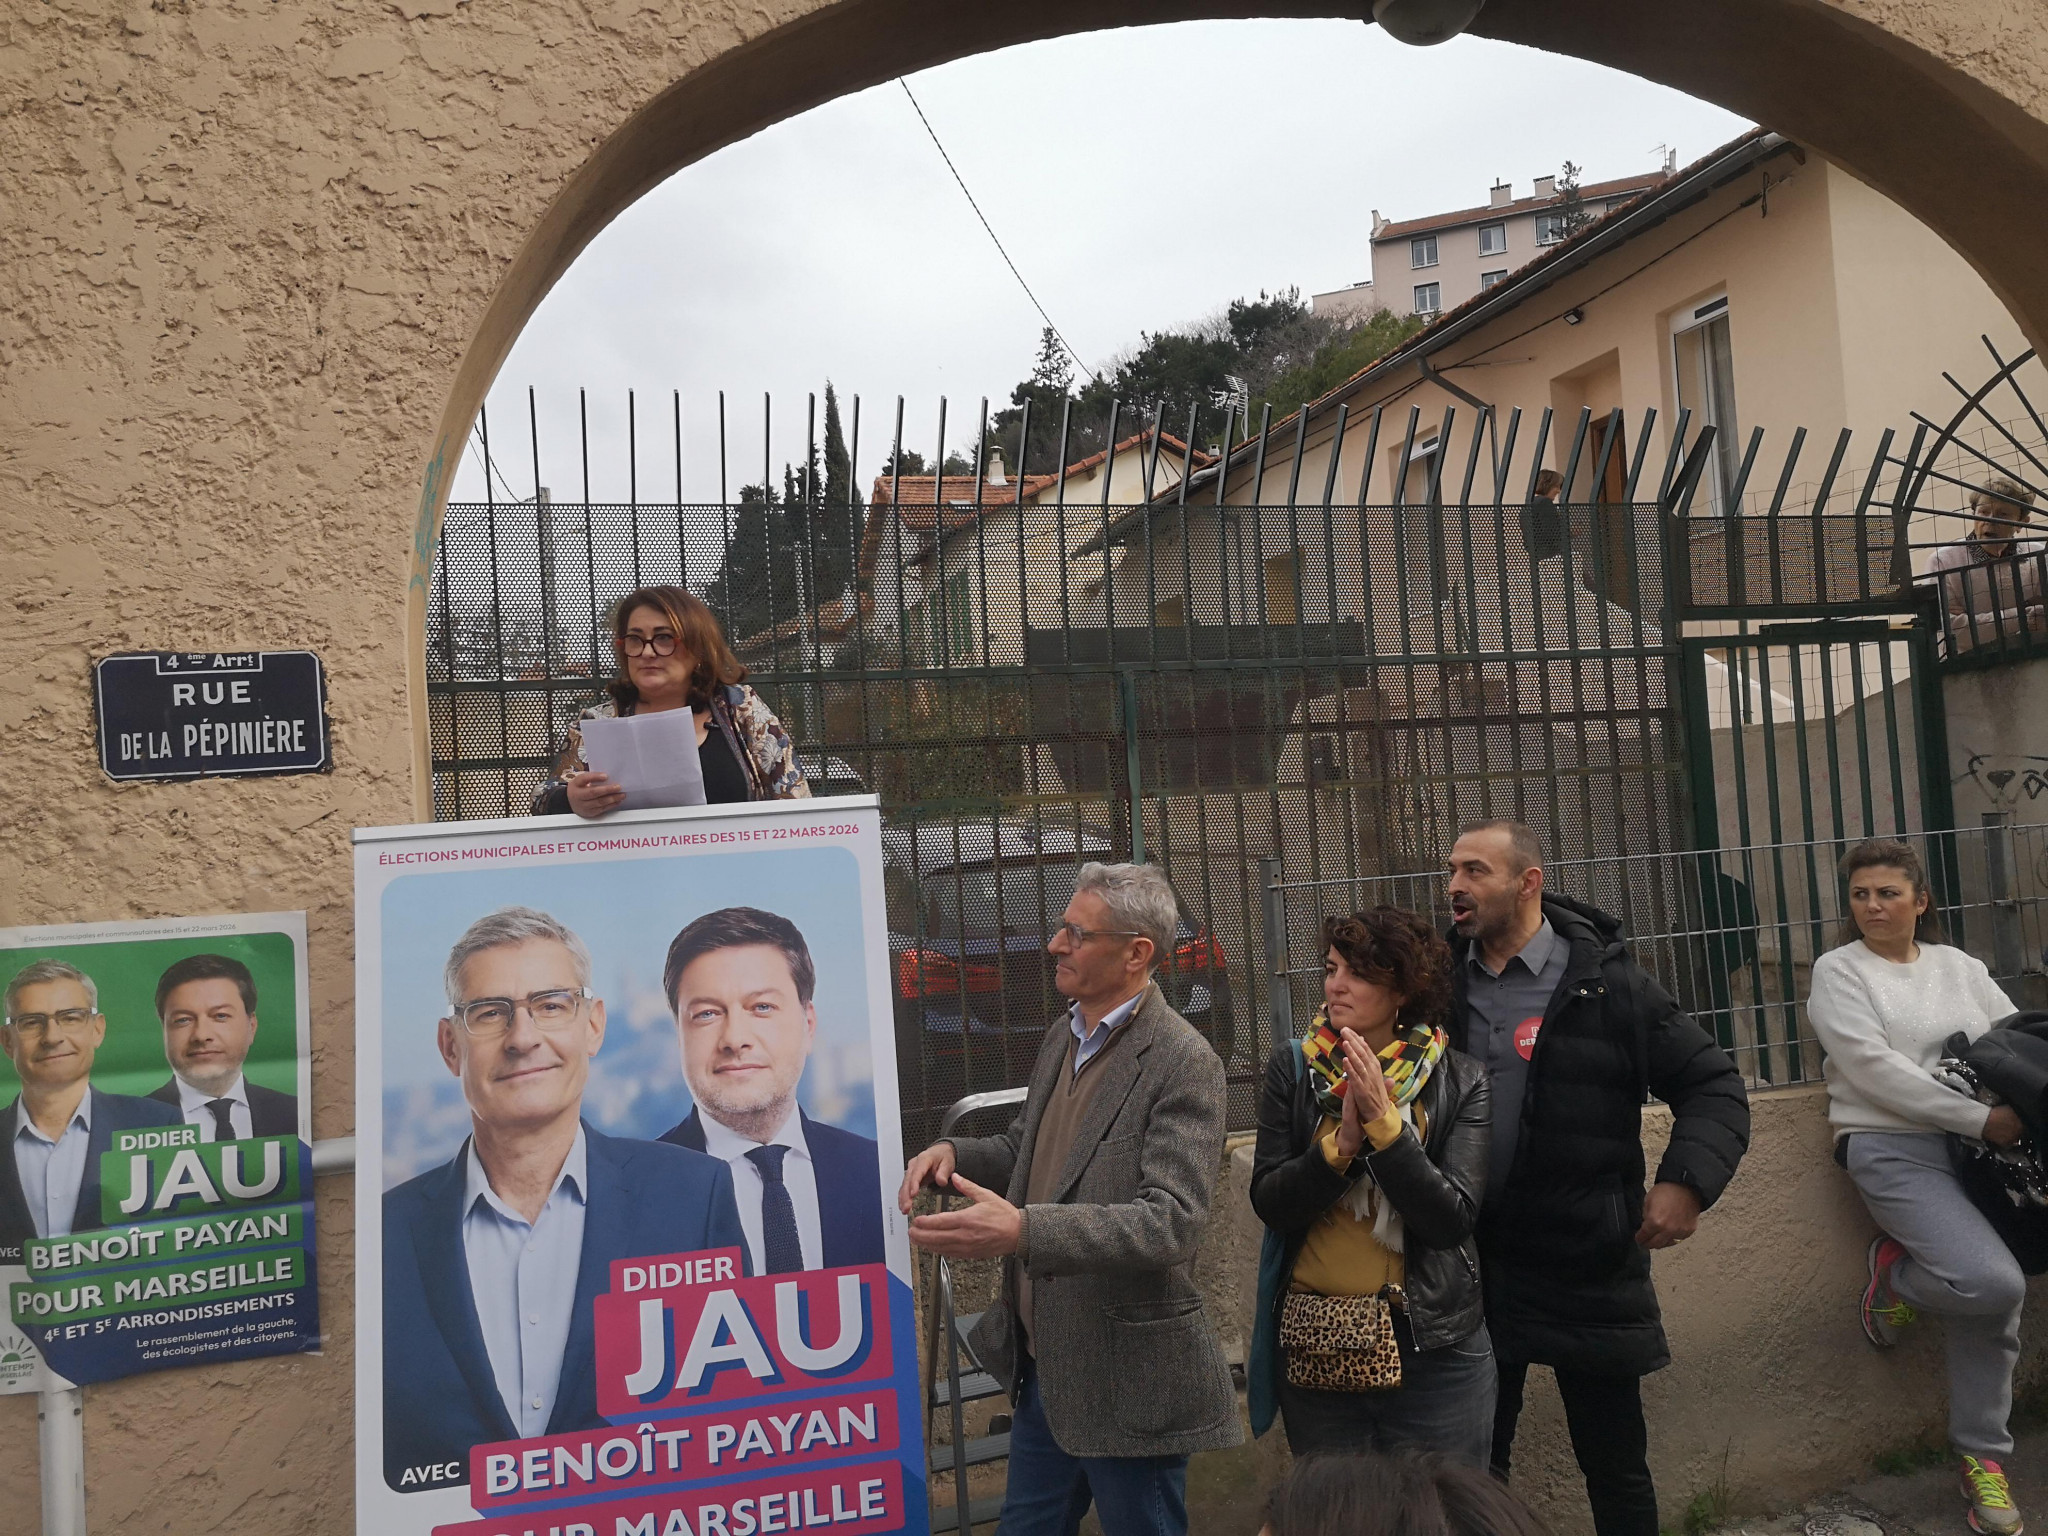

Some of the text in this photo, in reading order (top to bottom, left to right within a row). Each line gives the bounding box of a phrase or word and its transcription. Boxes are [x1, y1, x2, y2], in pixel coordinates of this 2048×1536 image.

[167, 655, 179, 668] 4
[173, 681, 251, 706] RUE
[121, 715, 306, 760] DE LA PÉPINIÈRE
[379, 823, 860, 866] ÉLECTIONS MUNICIPALES ET COMMUNAUTAIRES DES 15 ET 22 MARS 2026
[56, 932, 96, 941] municipales
[105, 928, 161, 938] communautaires
[120, 1129, 196, 1151] DIDIER
[120, 1140, 281, 1214] JAU
[0, 1213, 288, 1269] VEC BENOÎT PAYAN
[17, 1257, 293, 1314] POUR MARSEILLE
[623, 1256, 736, 1292] DIDIER
[66, 1323, 89, 1340] ET
[117, 1293, 295, 1331] ARRONDISSEMENTS
[137, 1317, 297, 1348] Le rassemblement de la gauche,
[624, 1273, 865, 1397] JAU
[142, 1329, 297, 1359] des écologistes et des citoyens.
[399, 1403, 876, 1494] AVEC BENOÎT PAYAN
[616, 1478, 886, 1536] MARSEILLE
